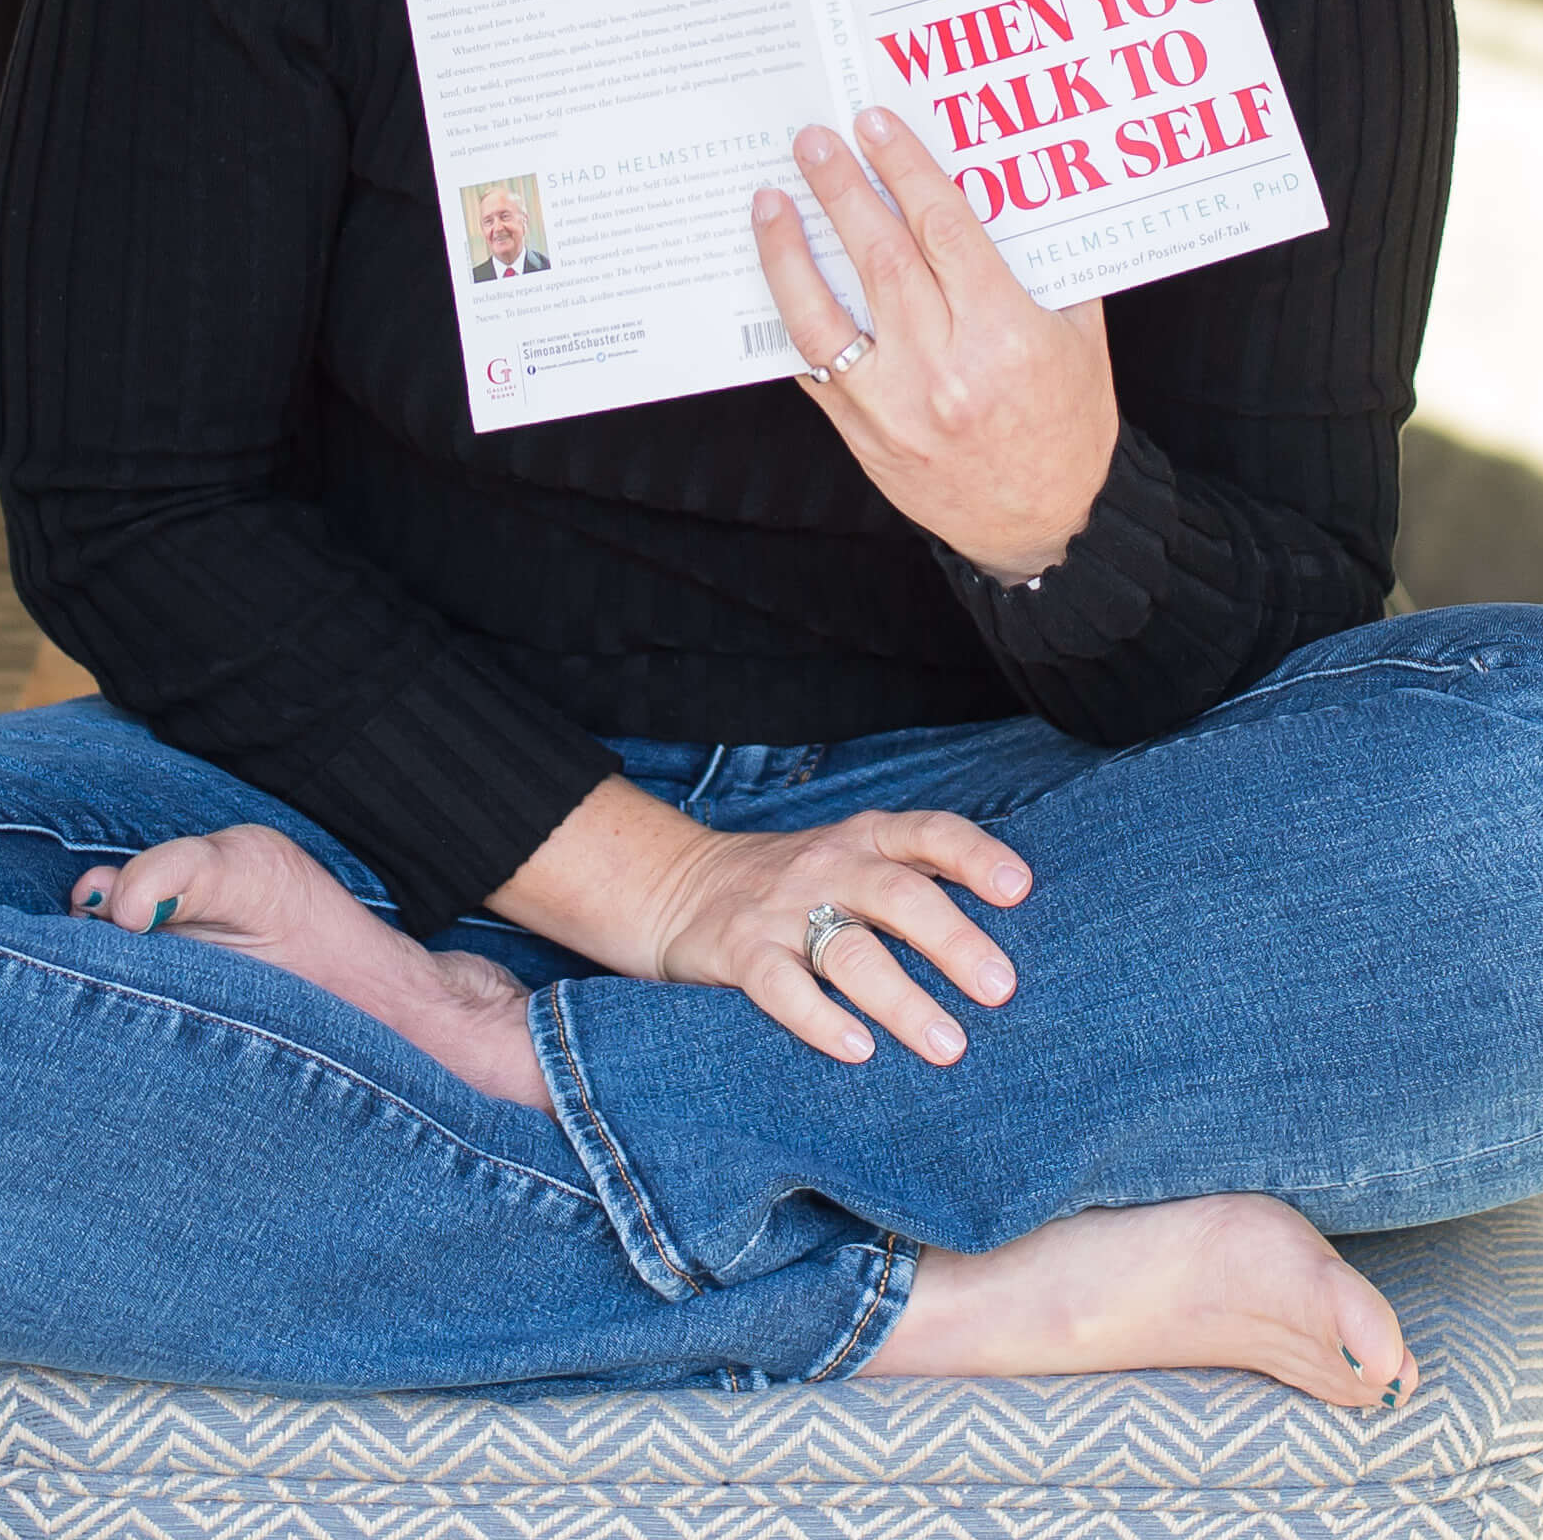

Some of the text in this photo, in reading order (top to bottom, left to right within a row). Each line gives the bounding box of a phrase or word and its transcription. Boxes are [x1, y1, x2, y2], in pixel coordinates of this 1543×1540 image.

[932, 56, 1113, 153] TALK
[1109, 29, 1207, 100] TO
[547, 164, 605, 188] SHAD
[949, 138, 1113, 226] OUR
[1114, 80, 1273, 178] SELF
[1026, 172, 1298, 268] HELMSTETTER, PhD
[1027, 220, 1250, 300] hor of 365 Days of Positive Self-Talk
[523, 330, 644, 359] SimonandSchuster.com
